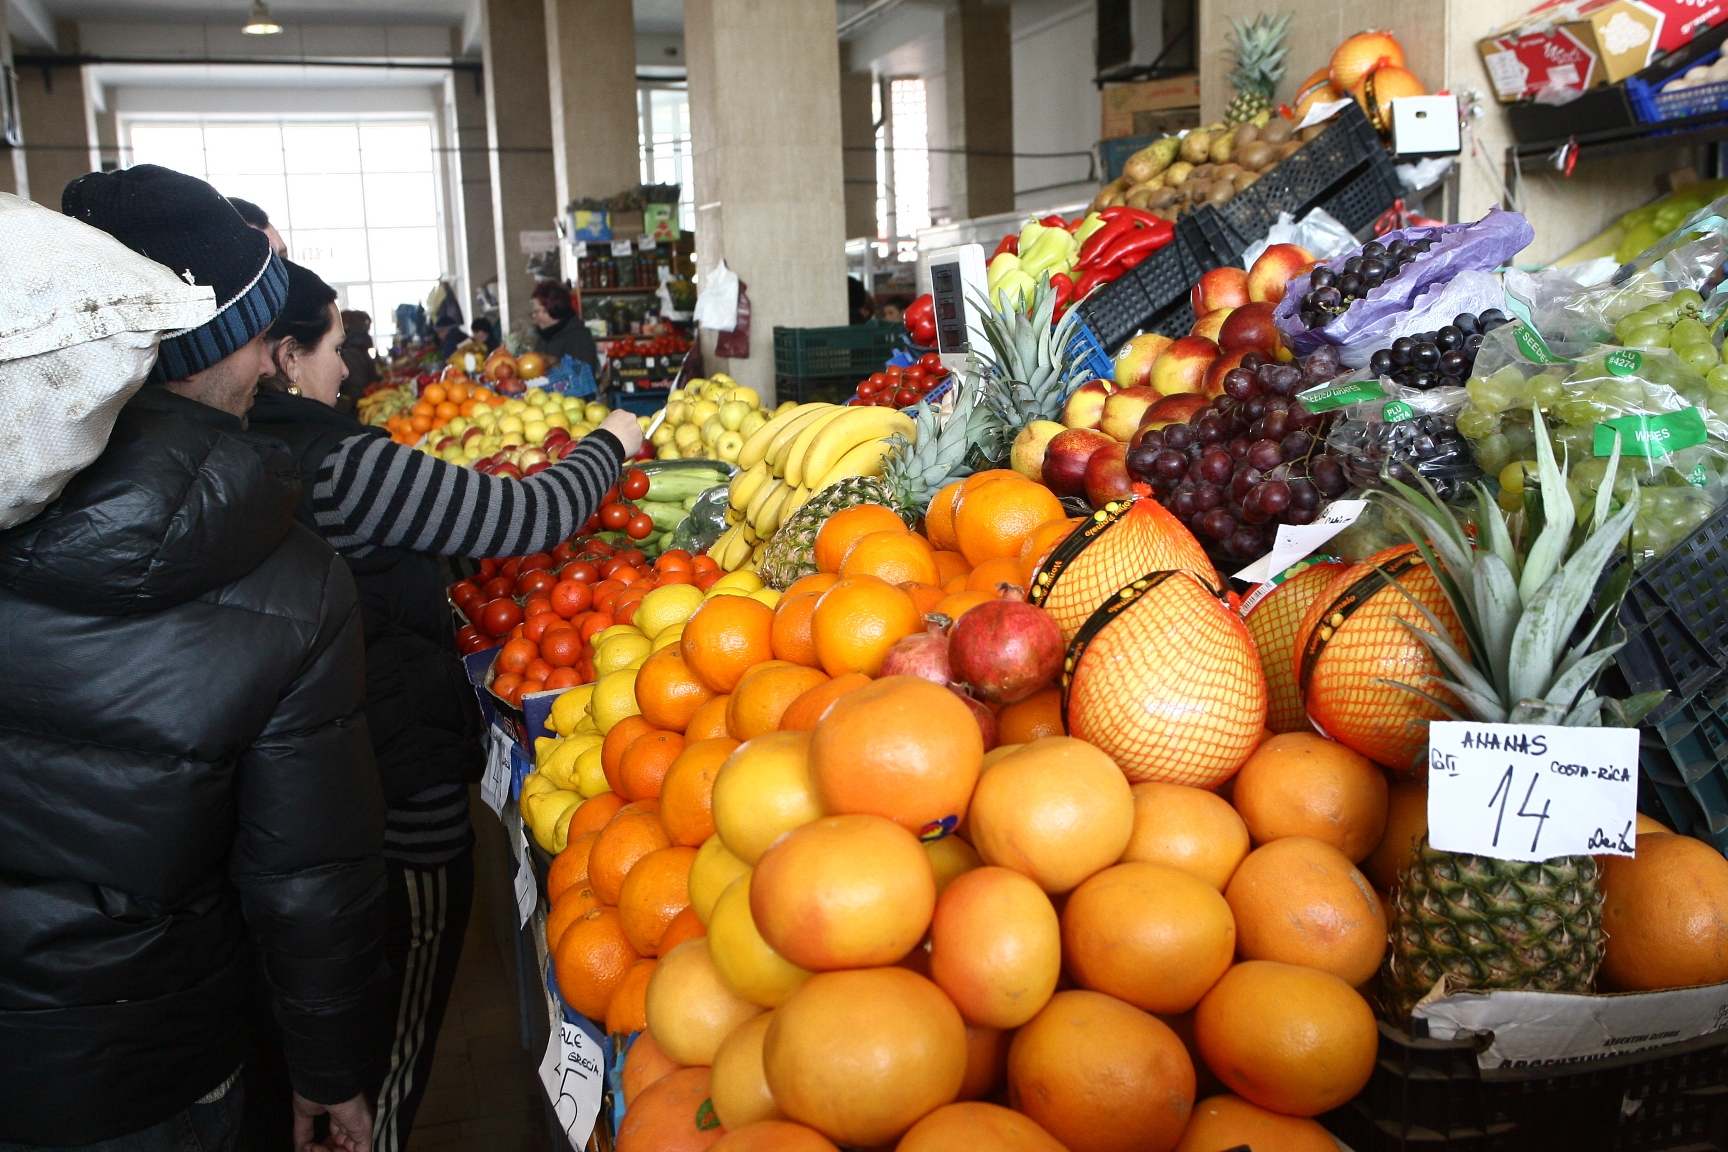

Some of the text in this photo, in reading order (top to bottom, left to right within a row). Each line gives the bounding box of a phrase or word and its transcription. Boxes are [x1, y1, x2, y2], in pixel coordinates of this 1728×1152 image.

[1608, 356, 1636, 370] #4274
[1387, 404, 1402, 417] PLU
[1461, 730, 1548, 756] ANANAS
[1488, 764, 1550, 853] 14
